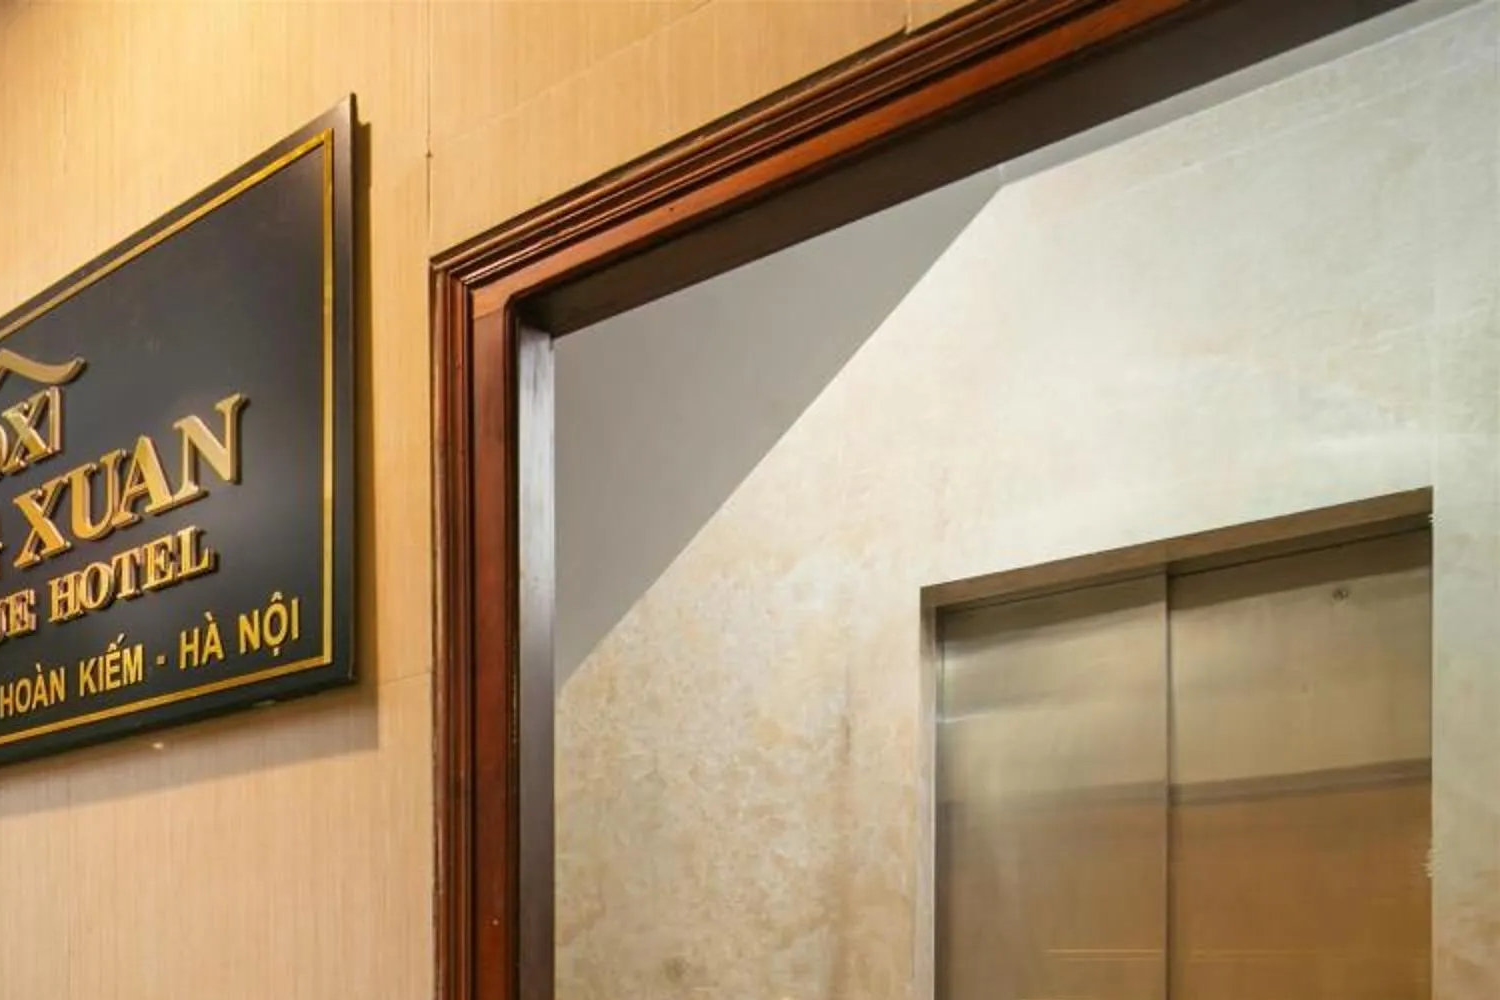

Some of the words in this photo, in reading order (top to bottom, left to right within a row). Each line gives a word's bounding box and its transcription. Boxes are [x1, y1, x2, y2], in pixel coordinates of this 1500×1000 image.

[13, 393, 250, 567] XUAN
[48, 525, 216, 623] HOTEL
[0, 663, 66, 718] HOÀN
[79, 633, 143, 697] KIẾM
[179, 611, 224, 669] HÀ
[238, 591, 299, 656] NỘI
